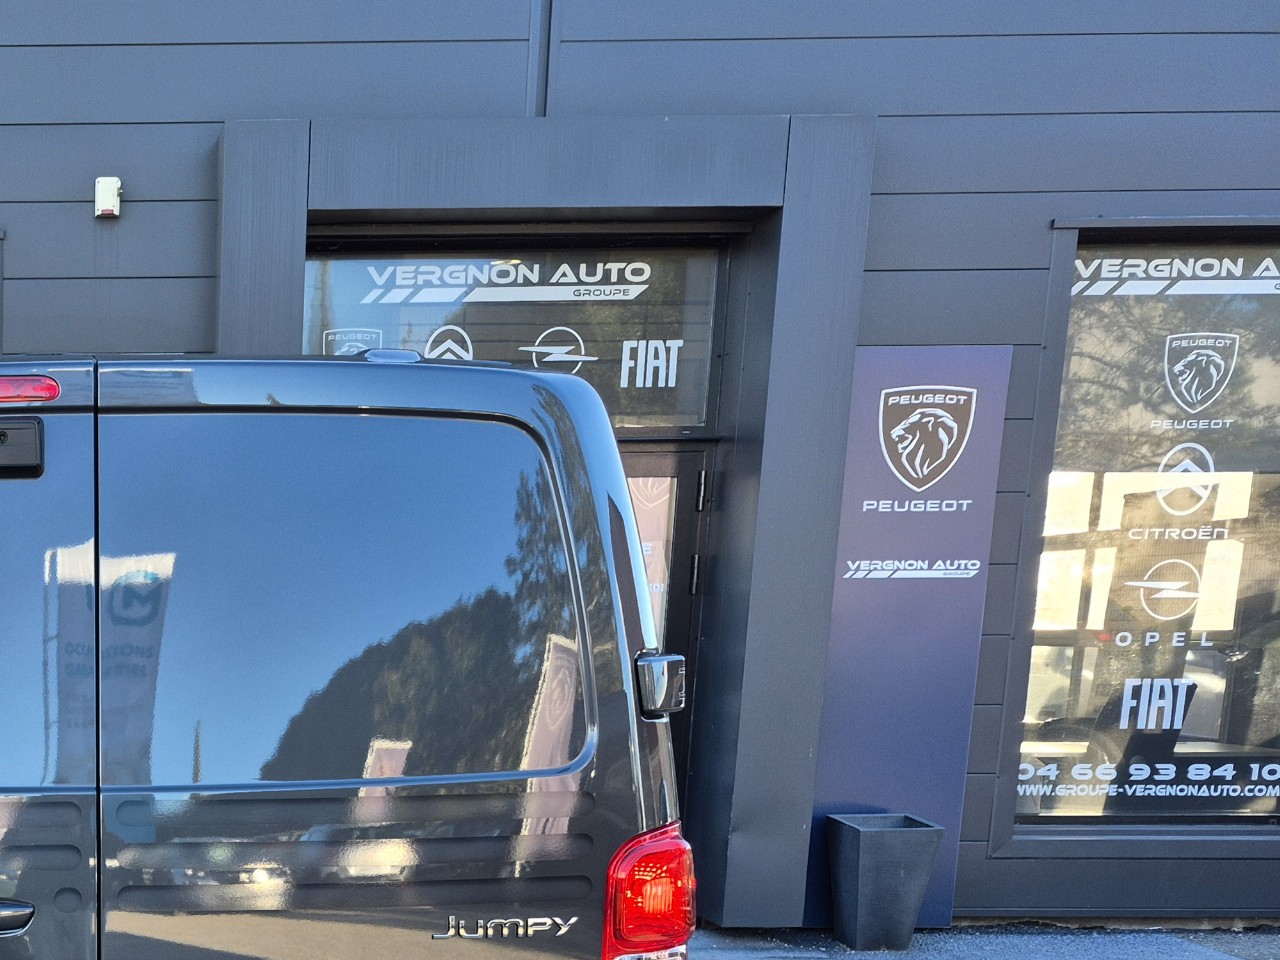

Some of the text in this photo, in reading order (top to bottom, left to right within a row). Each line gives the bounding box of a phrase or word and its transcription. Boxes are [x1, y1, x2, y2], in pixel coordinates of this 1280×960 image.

[367, 262, 651, 285] VERGNON AUTO
[1074, 257, 1244, 278] VERGNON
[572, 288, 631, 297] GROUPE
[328, 333, 377, 341] PEUGEOT
[1172, 339, 1233, 347] PEUGEOT
[620, 339, 683, 388] FIAT
[888, 394, 968, 406] PEUGEOT
[1150, 420, 1234, 429] PEUGEOT
[862, 500, 973, 512] PEUGEOT
[846, 560, 981, 571] VERGNON AUTO
[1115, 631, 1215, 647] OPEL
[1119, 678, 1196, 730] FIAT
[1017, 763, 1280, 781] 04 66 93 84 10
